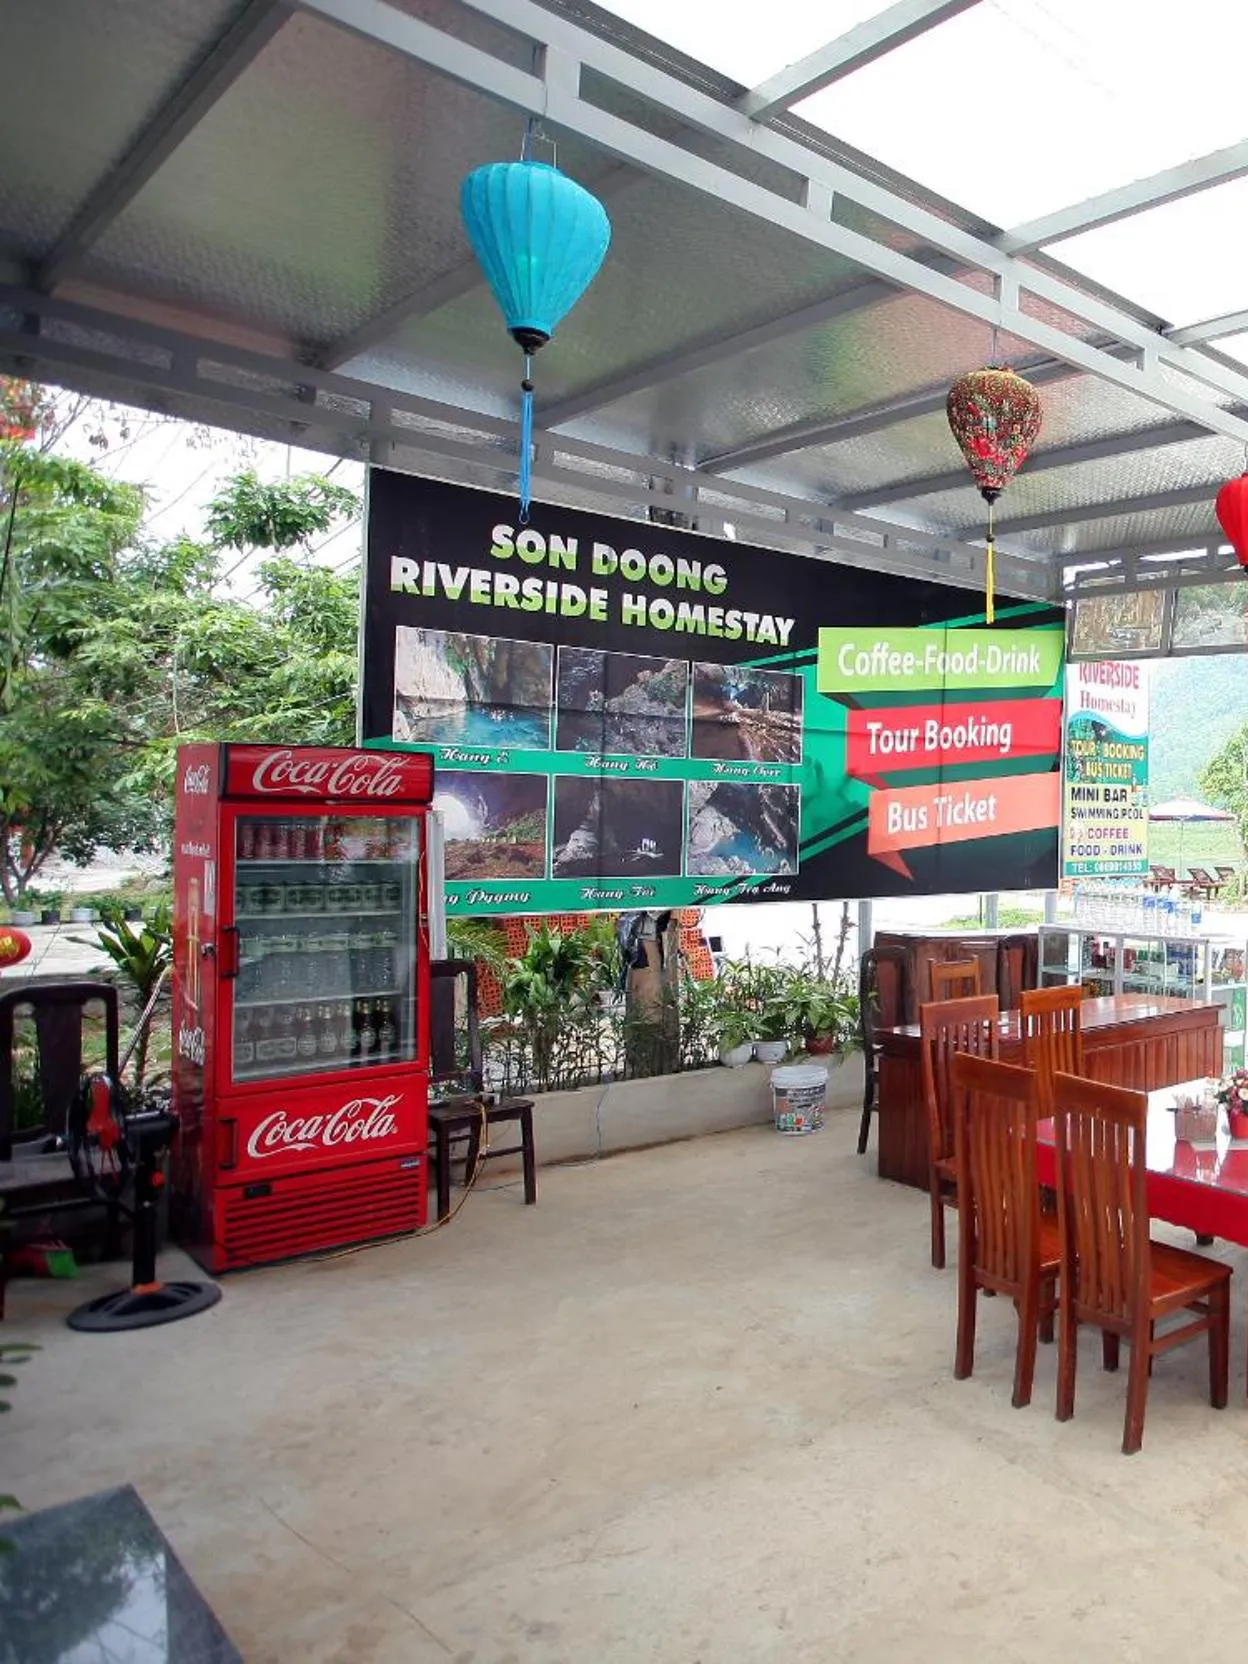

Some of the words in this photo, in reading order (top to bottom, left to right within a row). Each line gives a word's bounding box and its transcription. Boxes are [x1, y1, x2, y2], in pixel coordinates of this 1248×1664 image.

[490, 524, 579, 571] SON
[592, 541, 729, 596] DOONG
[390, 555, 609, 622] RIVERSIDE
[622, 593, 796, 647] HOMESTAY
[866, 721, 919, 755] Tour
[923, 716, 1012, 753] Booking
[1070, 786, 1100, 803] MINI
[1103, 787, 1128, 803] BAR
[887, 802, 928, 835] Bus
[933, 794, 997, 829] Ticket
[1087, 827, 1129, 840] COFFEE
[1070, 844, 1101, 857] FOOD
[1110, 843, 1143, 856] DRINK
